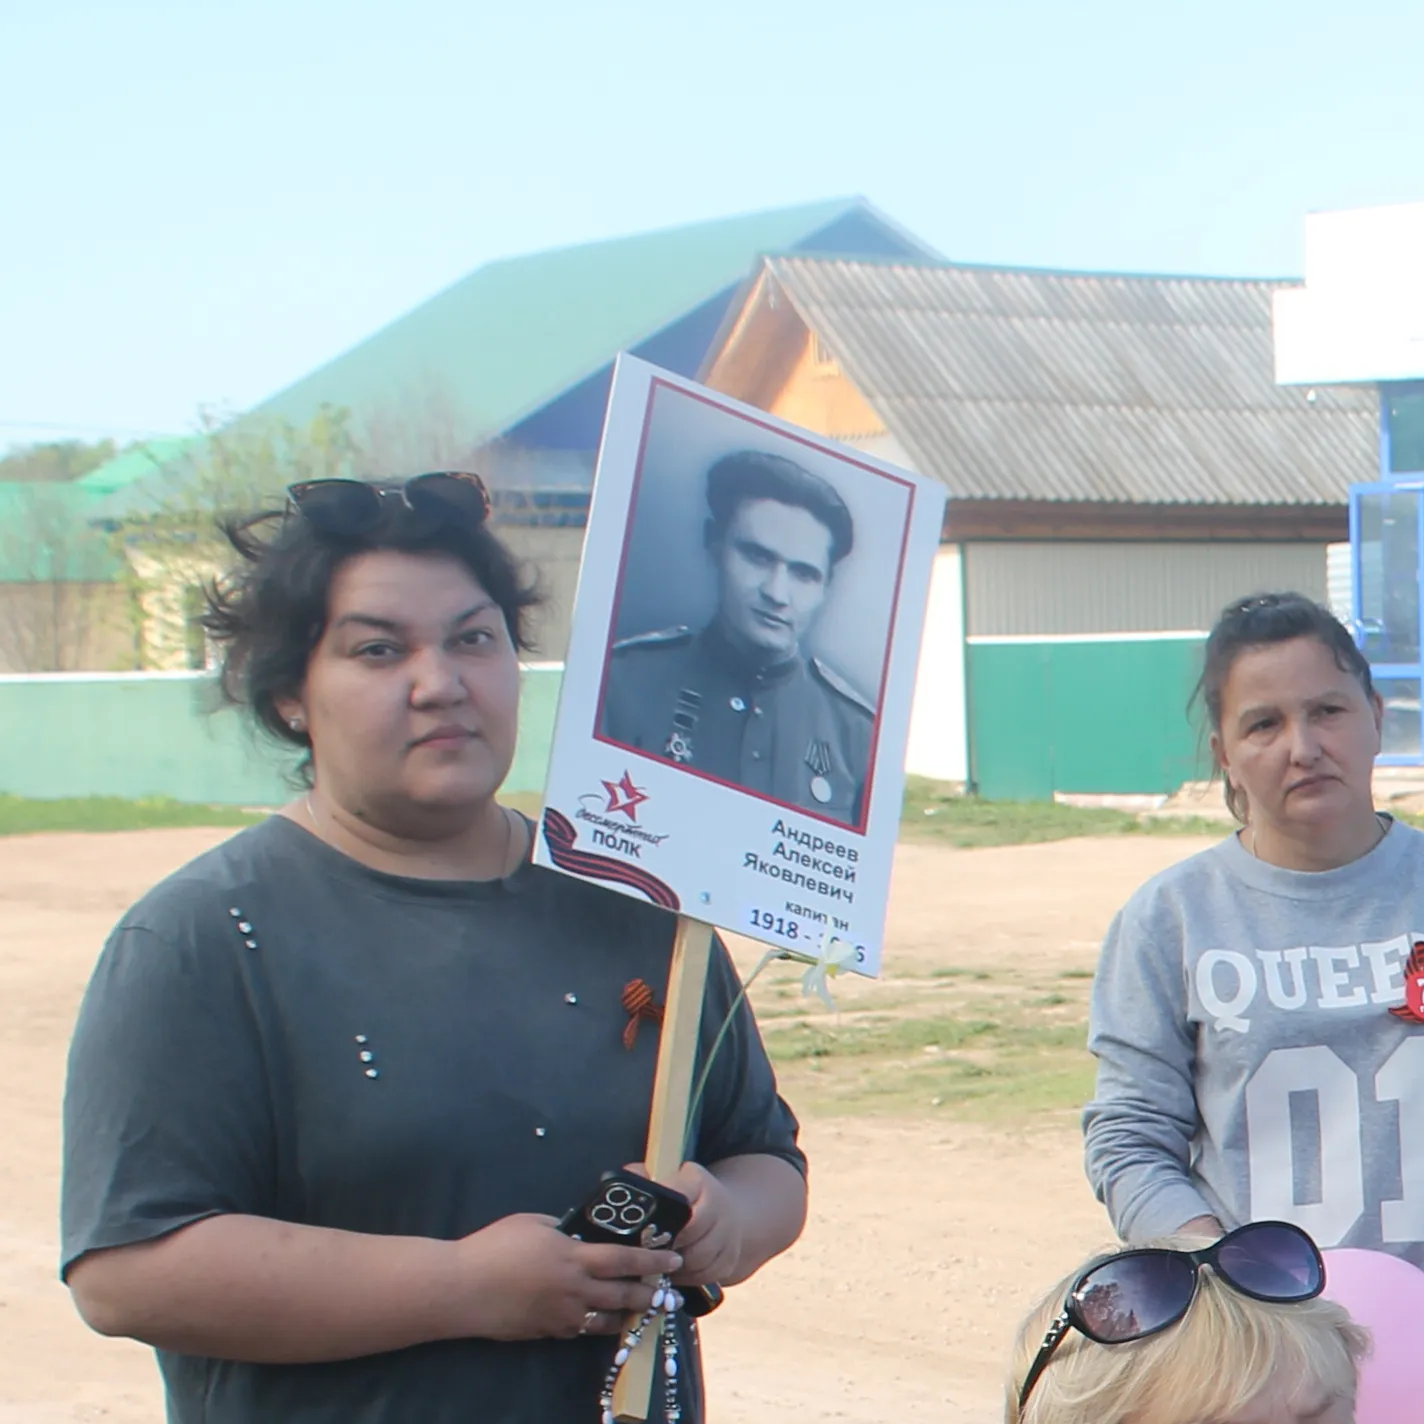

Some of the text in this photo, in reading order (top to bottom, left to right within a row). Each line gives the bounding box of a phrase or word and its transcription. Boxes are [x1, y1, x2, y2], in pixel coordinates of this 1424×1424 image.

[592, 829, 642, 859] ПОЛК
[772, 818, 859, 863] Андреев
[742, 851, 855, 904] Яковлевич
[772, 841, 857, 883] Алексей
[750, 908, 799, 940] 1918
